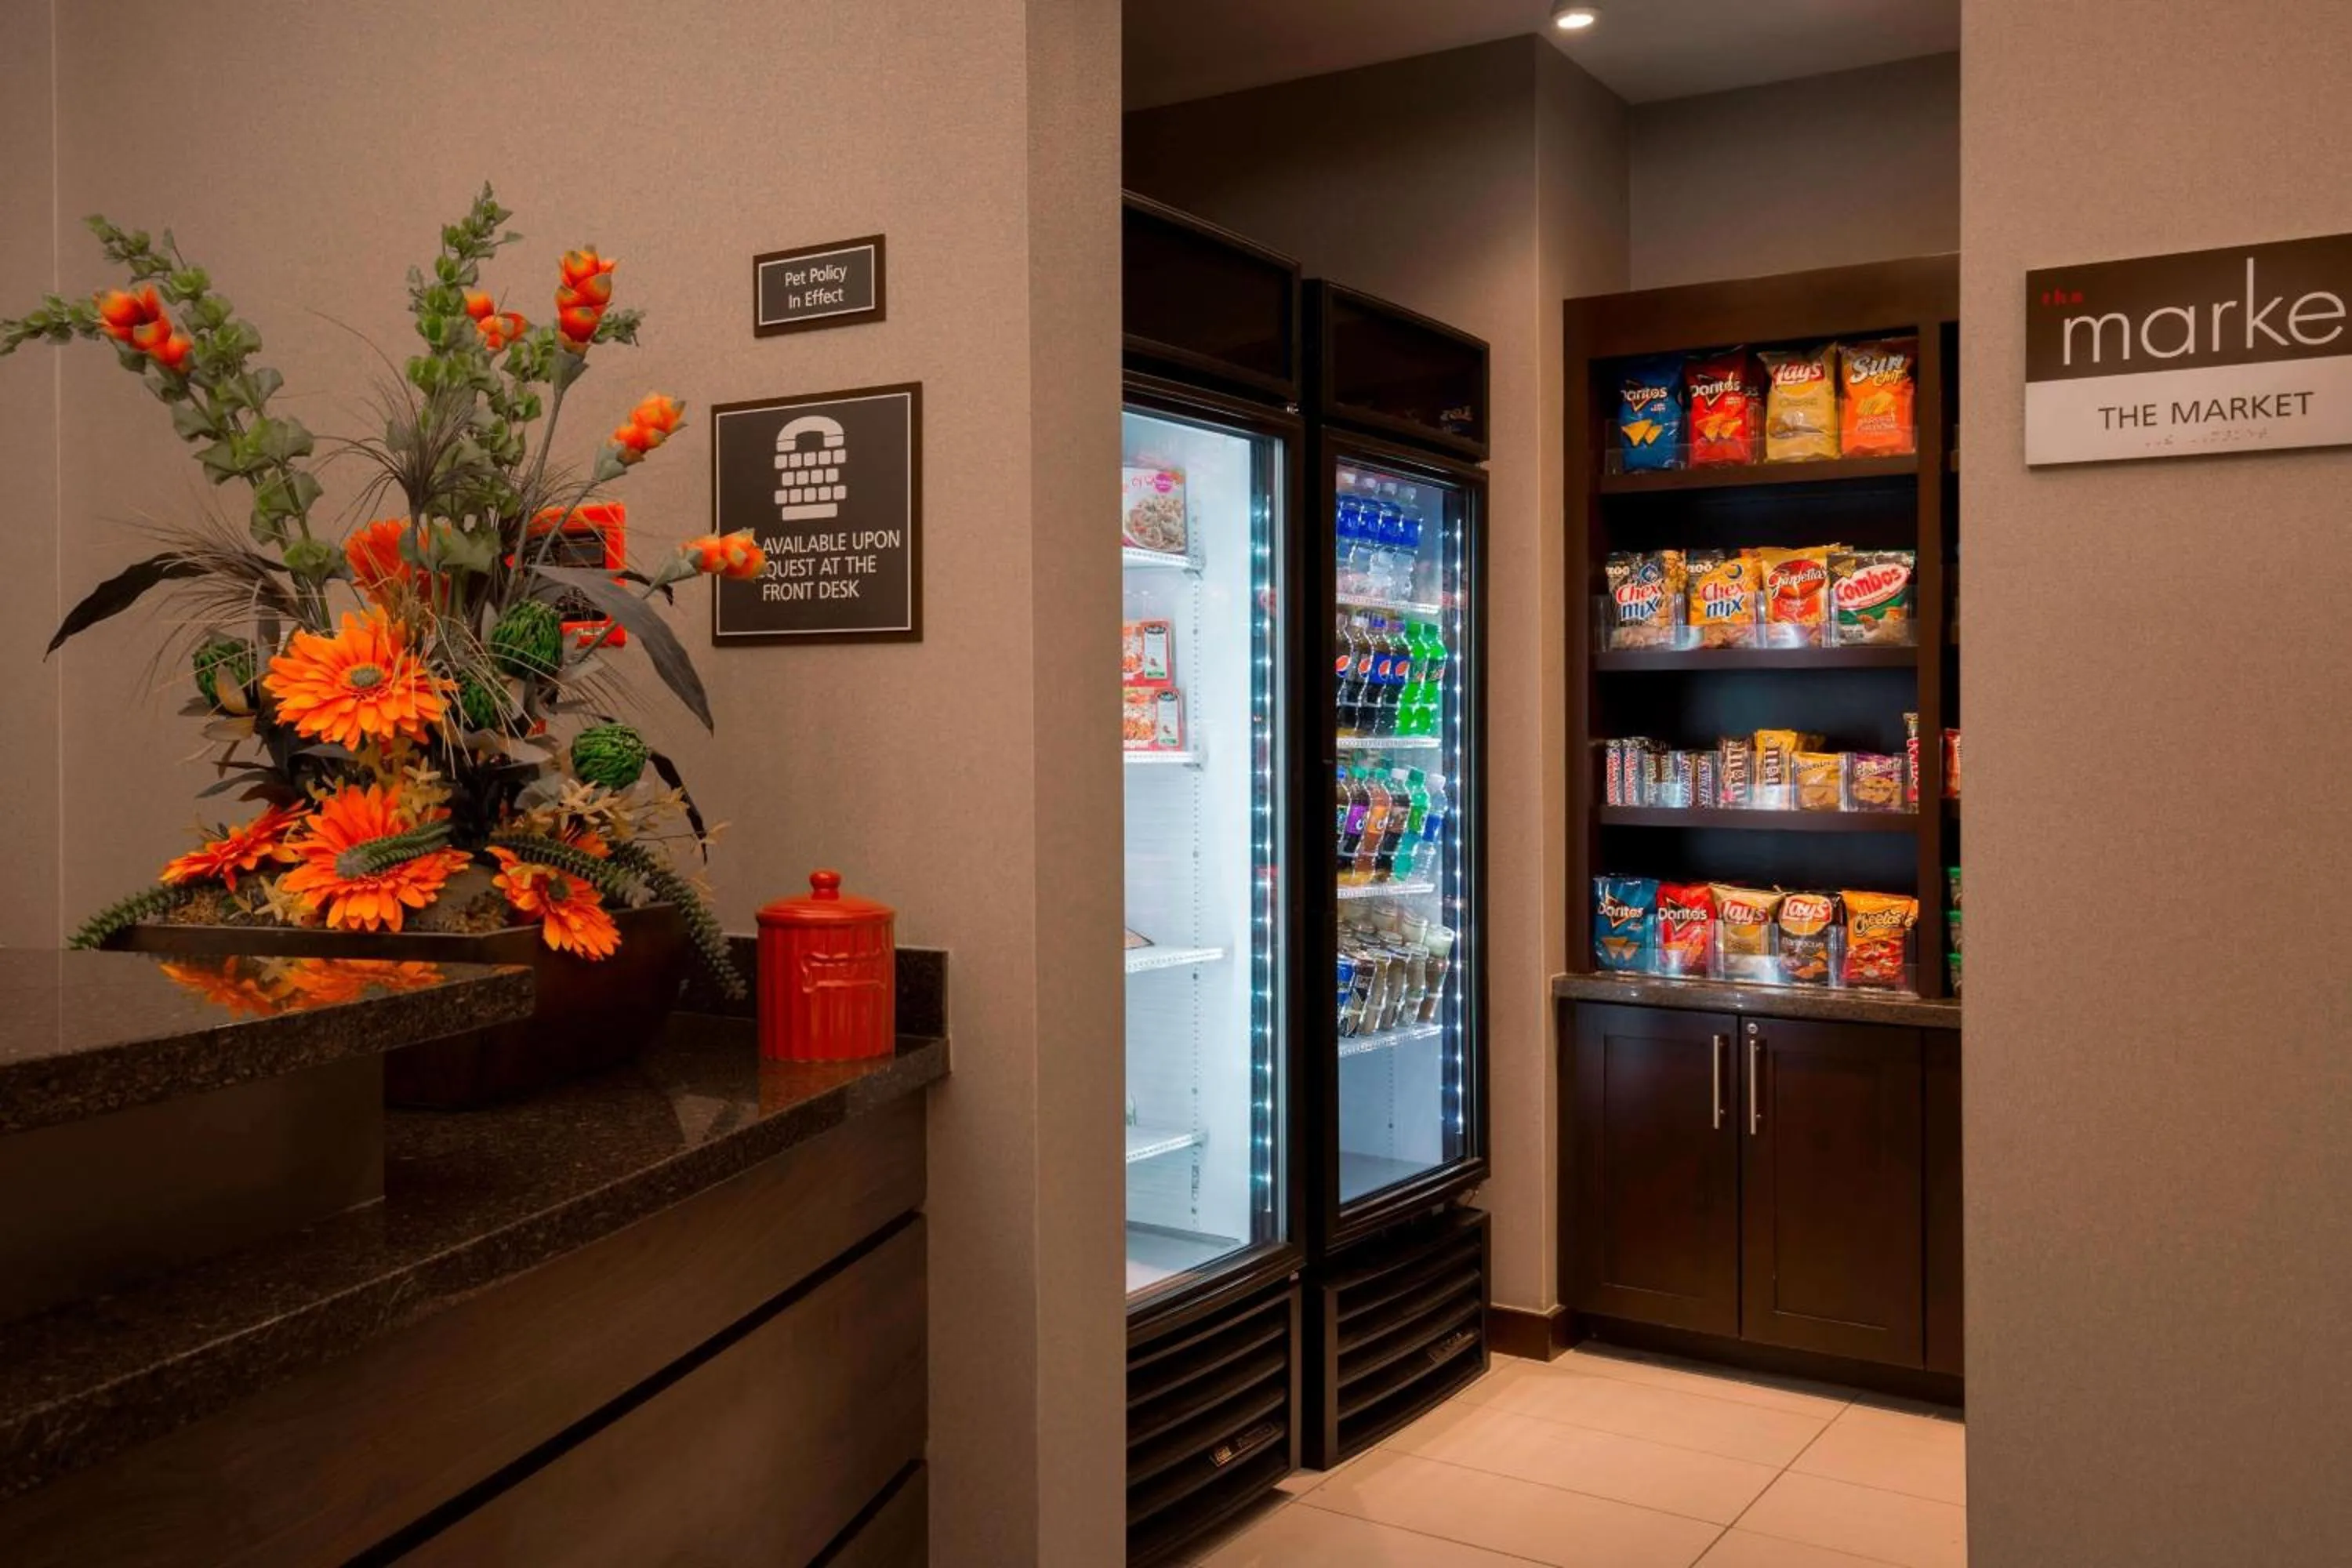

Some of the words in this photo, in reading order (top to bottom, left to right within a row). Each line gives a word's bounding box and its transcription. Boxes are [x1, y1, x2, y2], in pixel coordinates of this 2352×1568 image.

[785, 270, 806, 287] Pet
[810, 264, 848, 283] Policy
[788, 294, 801, 310] In
[805, 288, 844, 307] Effect
[2062, 257, 2347, 365] marke
[2098, 403, 2158, 430] THE
[2171, 391, 2315, 425] MARKET
[762, 532, 848, 554] AVAILABLE
[851, 529, 901, 550] UPON
[757, 558, 815, 580] QUEST
[819, 557, 841, 575] AT
[844, 554, 877, 575] THE
[762, 582, 815, 602] FRONT
[818, 579, 861, 599] DESK
[1617, 584, 1660, 603] Chex
[1700, 583, 1744, 601] Chex
[1835, 567, 1903, 604] Combos
[1621, 596, 1660, 620] mix
[1705, 595, 1744, 618] mix
[1596, 902, 1644, 917] Doritos
[1658, 907, 1708, 920] Doritos
[1855, 909, 1901, 936] Cheetos
